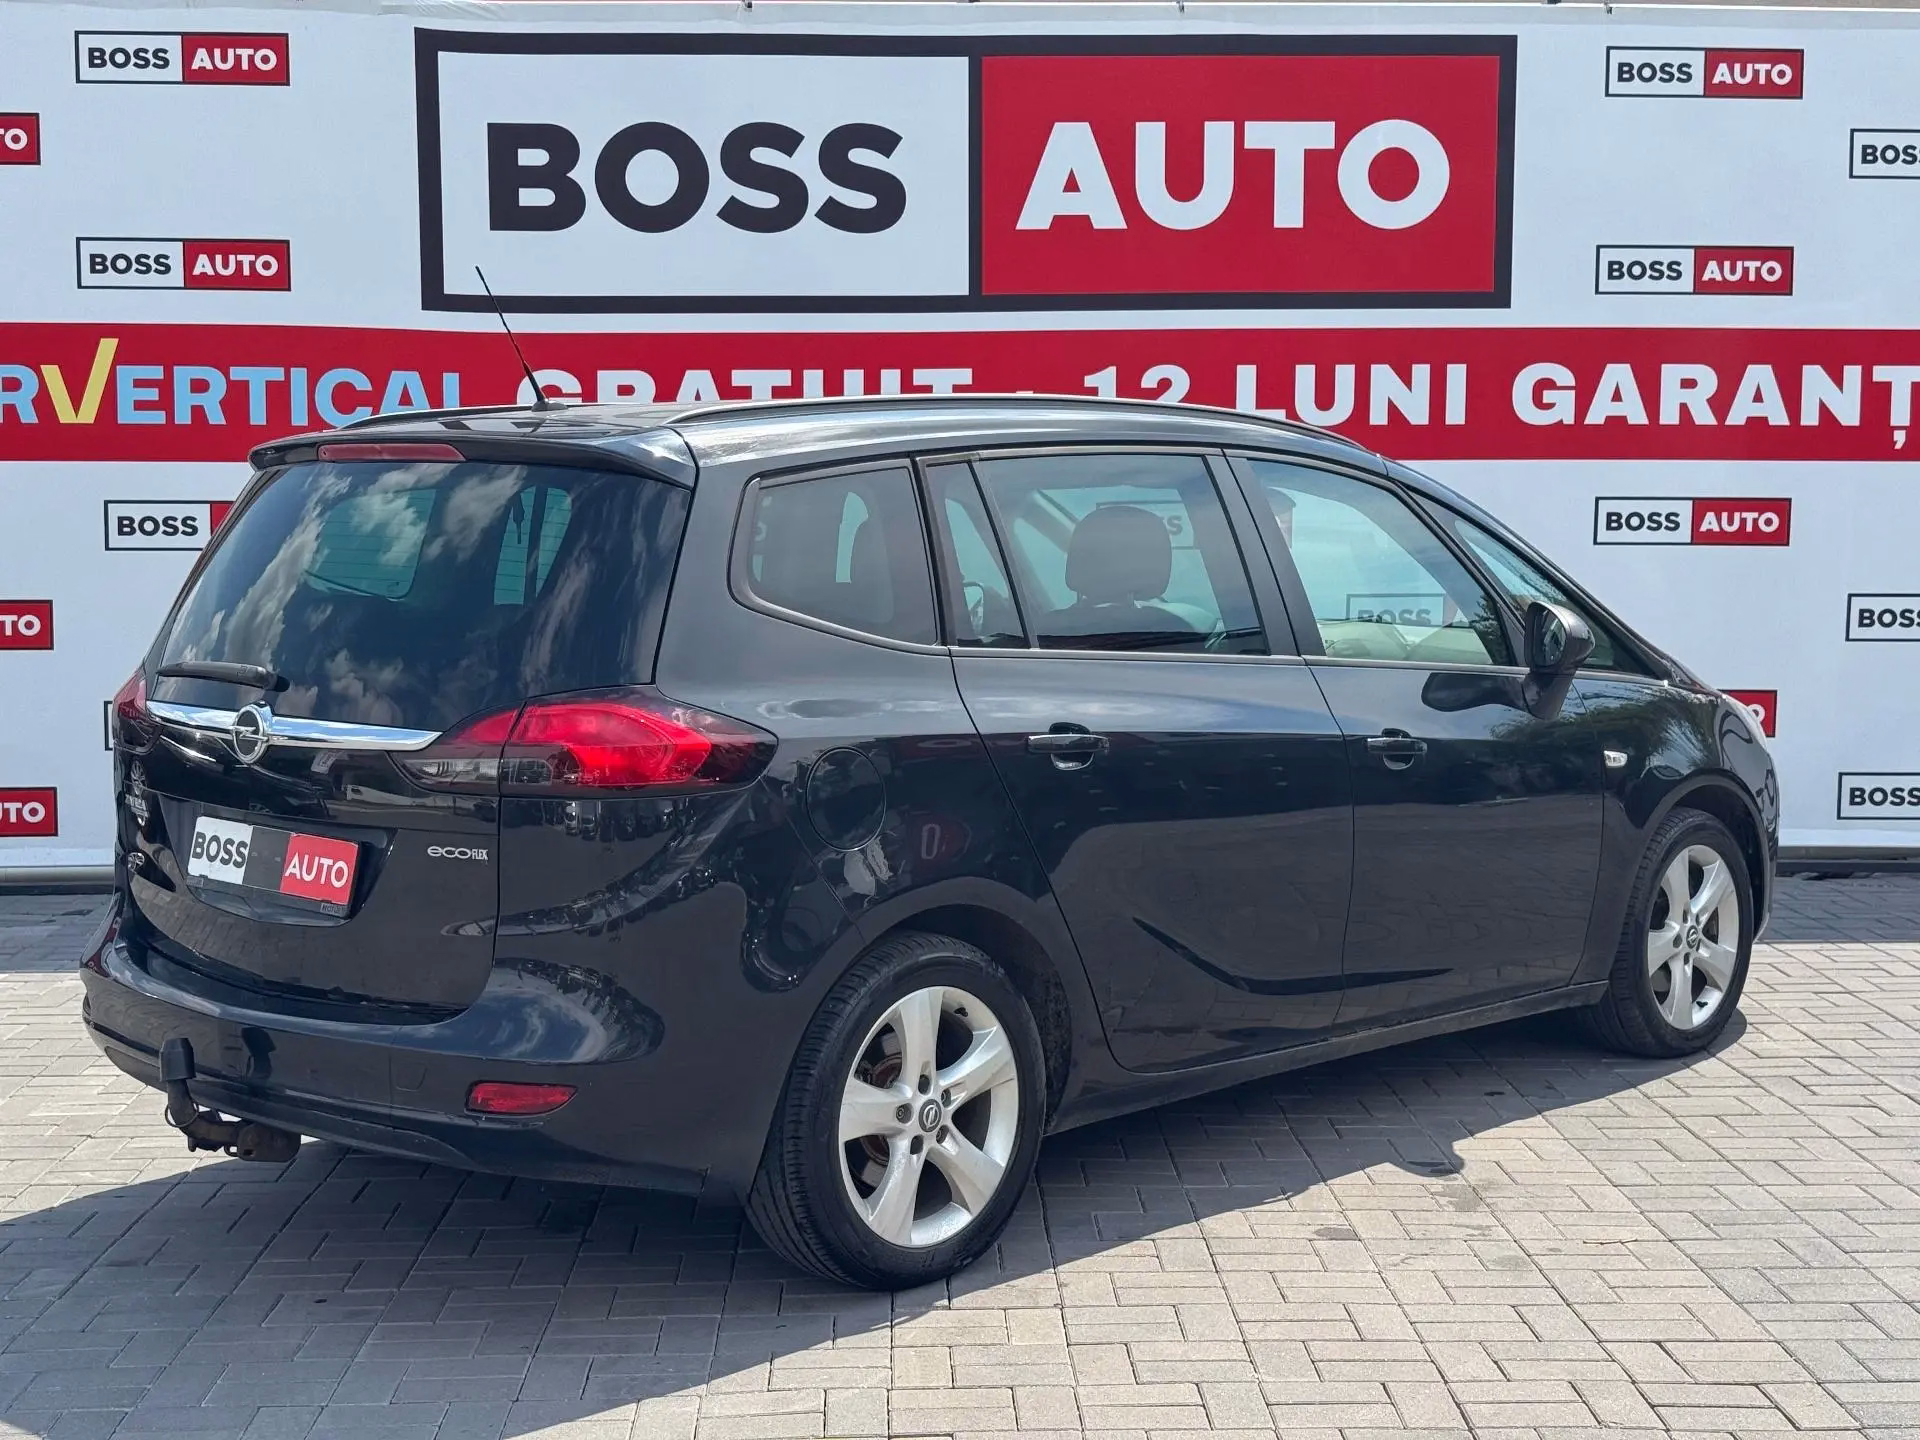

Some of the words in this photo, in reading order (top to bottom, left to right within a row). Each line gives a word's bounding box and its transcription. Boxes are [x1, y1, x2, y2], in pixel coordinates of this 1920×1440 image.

[87, 47, 170, 70] BOSS
[191, 47, 277, 71] AUTO
[1617, 62, 1693, 84] BOSS
[1711, 62, 1793, 85] AUTO
[0, 128, 28, 150] O
[1861, 144, 1920, 165] BOS
[486, 121, 907, 234] BOSS
[1015, 118, 1450, 231] AUTO
[88, 253, 172, 276] BOSS
[192, 253, 279, 277] AUTO
[1606, 260, 1683, 281] BOSS
[1701, 260, 1783, 282] AUTO
[1236, 363, 1468, 427] LUNI
[116, 515, 199, 537] BOSS
[1605, 511, 1681, 532] BOSS
[1699, 511, 1780, 533] AUTO
[1858, 608, 1920, 628] BOS
[1849, 787, 1920, 807] BOSS
[0, 801, 46, 823] TO
[191, 831, 249, 868] BOSS
[284, 852, 349, 888] AUTO
